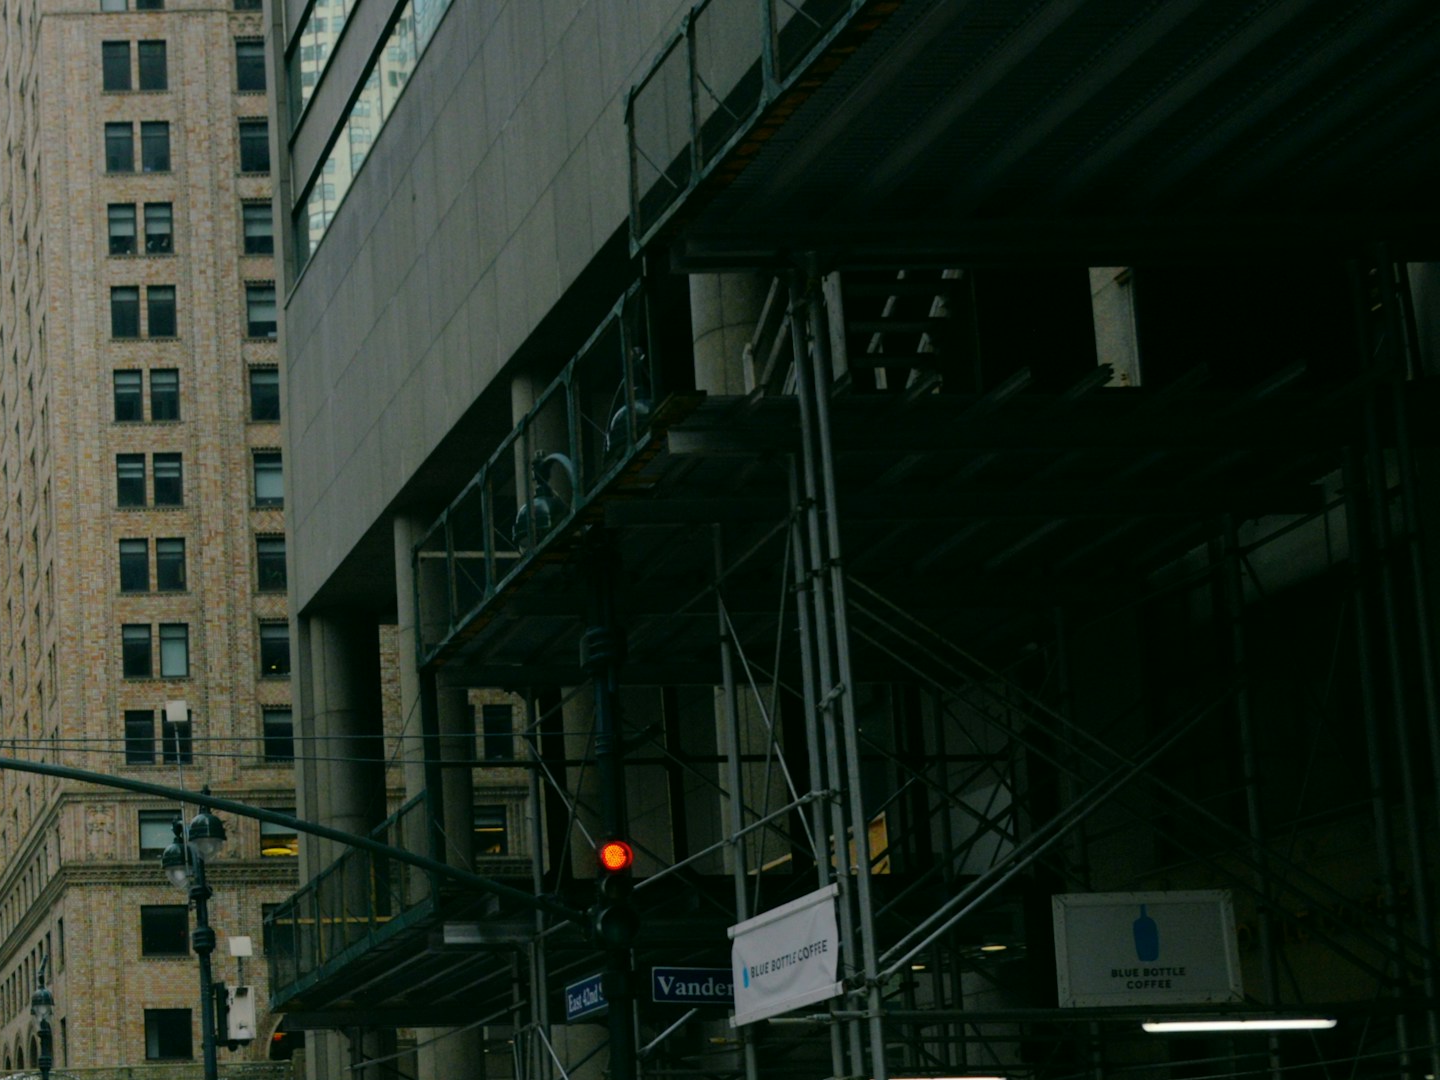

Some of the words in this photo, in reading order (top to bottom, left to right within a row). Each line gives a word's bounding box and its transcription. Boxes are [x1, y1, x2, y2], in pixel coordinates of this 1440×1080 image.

[750, 962, 769, 978] BLUE
[771, 952, 796, 972] BOTTLE
[797, 940, 828, 961] COFFEE
[1111, 969, 1139, 978] BLUE
[1144, 967, 1186, 977] BOTTLE
[1127, 980, 1172, 989] COFFEE
[568, 994, 582, 1013] East
